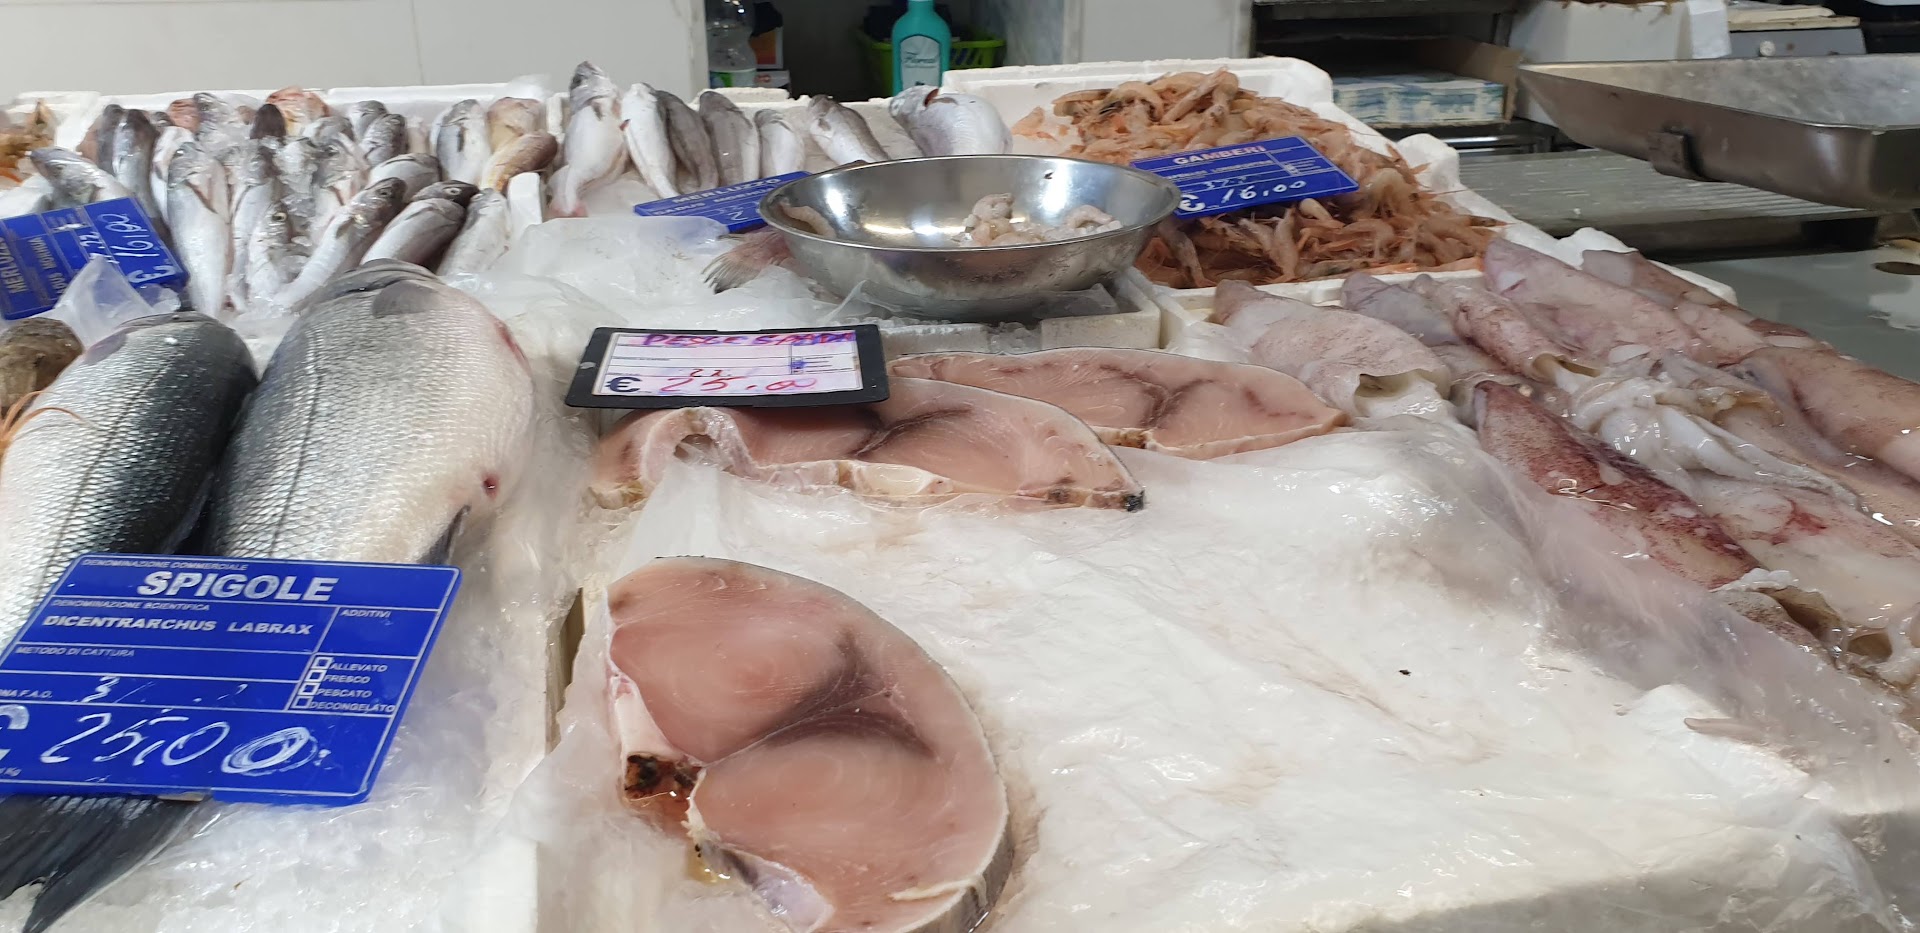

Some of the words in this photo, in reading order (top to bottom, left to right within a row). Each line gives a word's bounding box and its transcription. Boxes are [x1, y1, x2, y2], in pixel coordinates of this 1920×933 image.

[1173, 145, 1267, 166] GAMBERI
[672, 179, 781, 204] MERLUZZO
[1178, 193, 1207, 212] €
[1221, 180, 1306, 204] 16,00
[127, 264, 177, 284] €
[605, 376, 643, 392] €
[82, 559, 171, 569] DENOMINAZIONE
[171, 562, 248, 571] COMMERCIALE
[137, 571, 339, 601] SPIGOLE
[52, 600, 142, 609] DENOMINAZIONE
[142, 602, 210, 611] SCIENTIFICA
[341, 609, 392, 618] ADDITIVI
[42, 616, 217, 632] DICENTRARCHUS
[227, 622, 314, 635] LABRAX
[16, 646, 66, 655] METODO
[65, 647, 81, 656] DI
[80, 648, 134, 657] CATTURA
[329, 663, 388, 672] ALLEVATO
[322, 674, 371, 684] FRESCO
[315, 688, 373, 698] PESCATO
[309, 701, 396, 713] DECONGELATO
